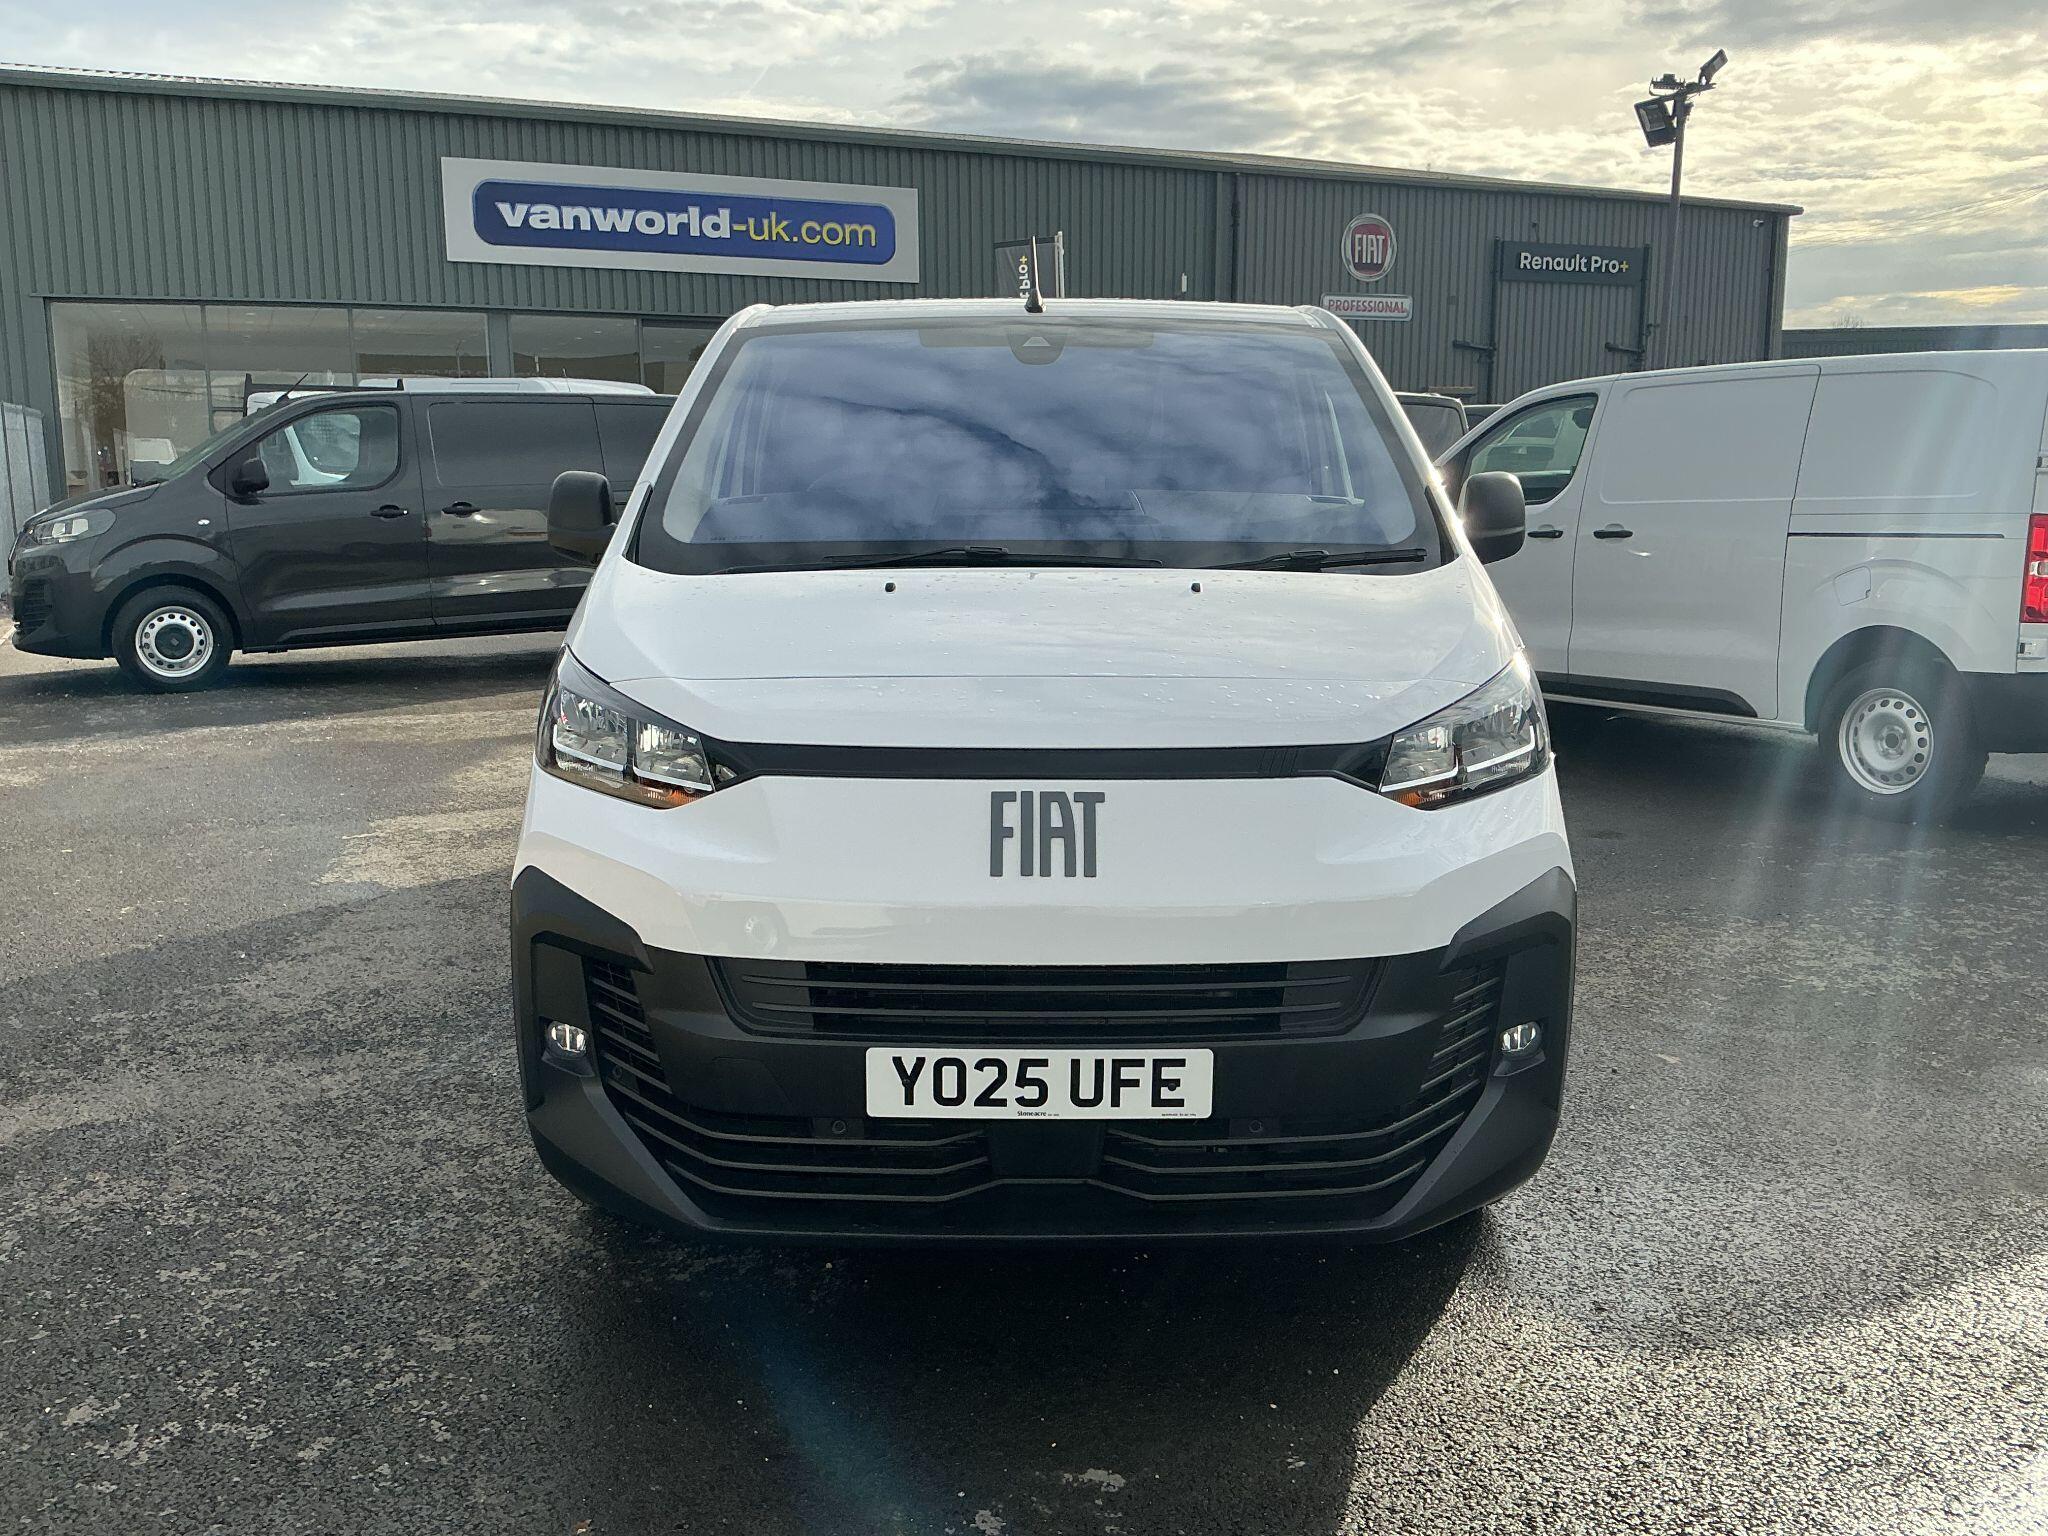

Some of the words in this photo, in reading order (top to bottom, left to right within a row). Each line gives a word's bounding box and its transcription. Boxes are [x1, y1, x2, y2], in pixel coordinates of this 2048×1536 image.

[495, 201, 877, 247] vanworld-uk.com
[1354, 234, 1386, 264] FIAT
[1519, 252, 1588, 272] Renault
[1590, 255, 1630, 274] Pro+
[1328, 299, 1408, 313] PROFESSIONAL
[990, 790, 1106, 877] FIAT
[891, 1056, 1049, 1108] YO25
[1069, 1058, 1187, 1108] UFE
